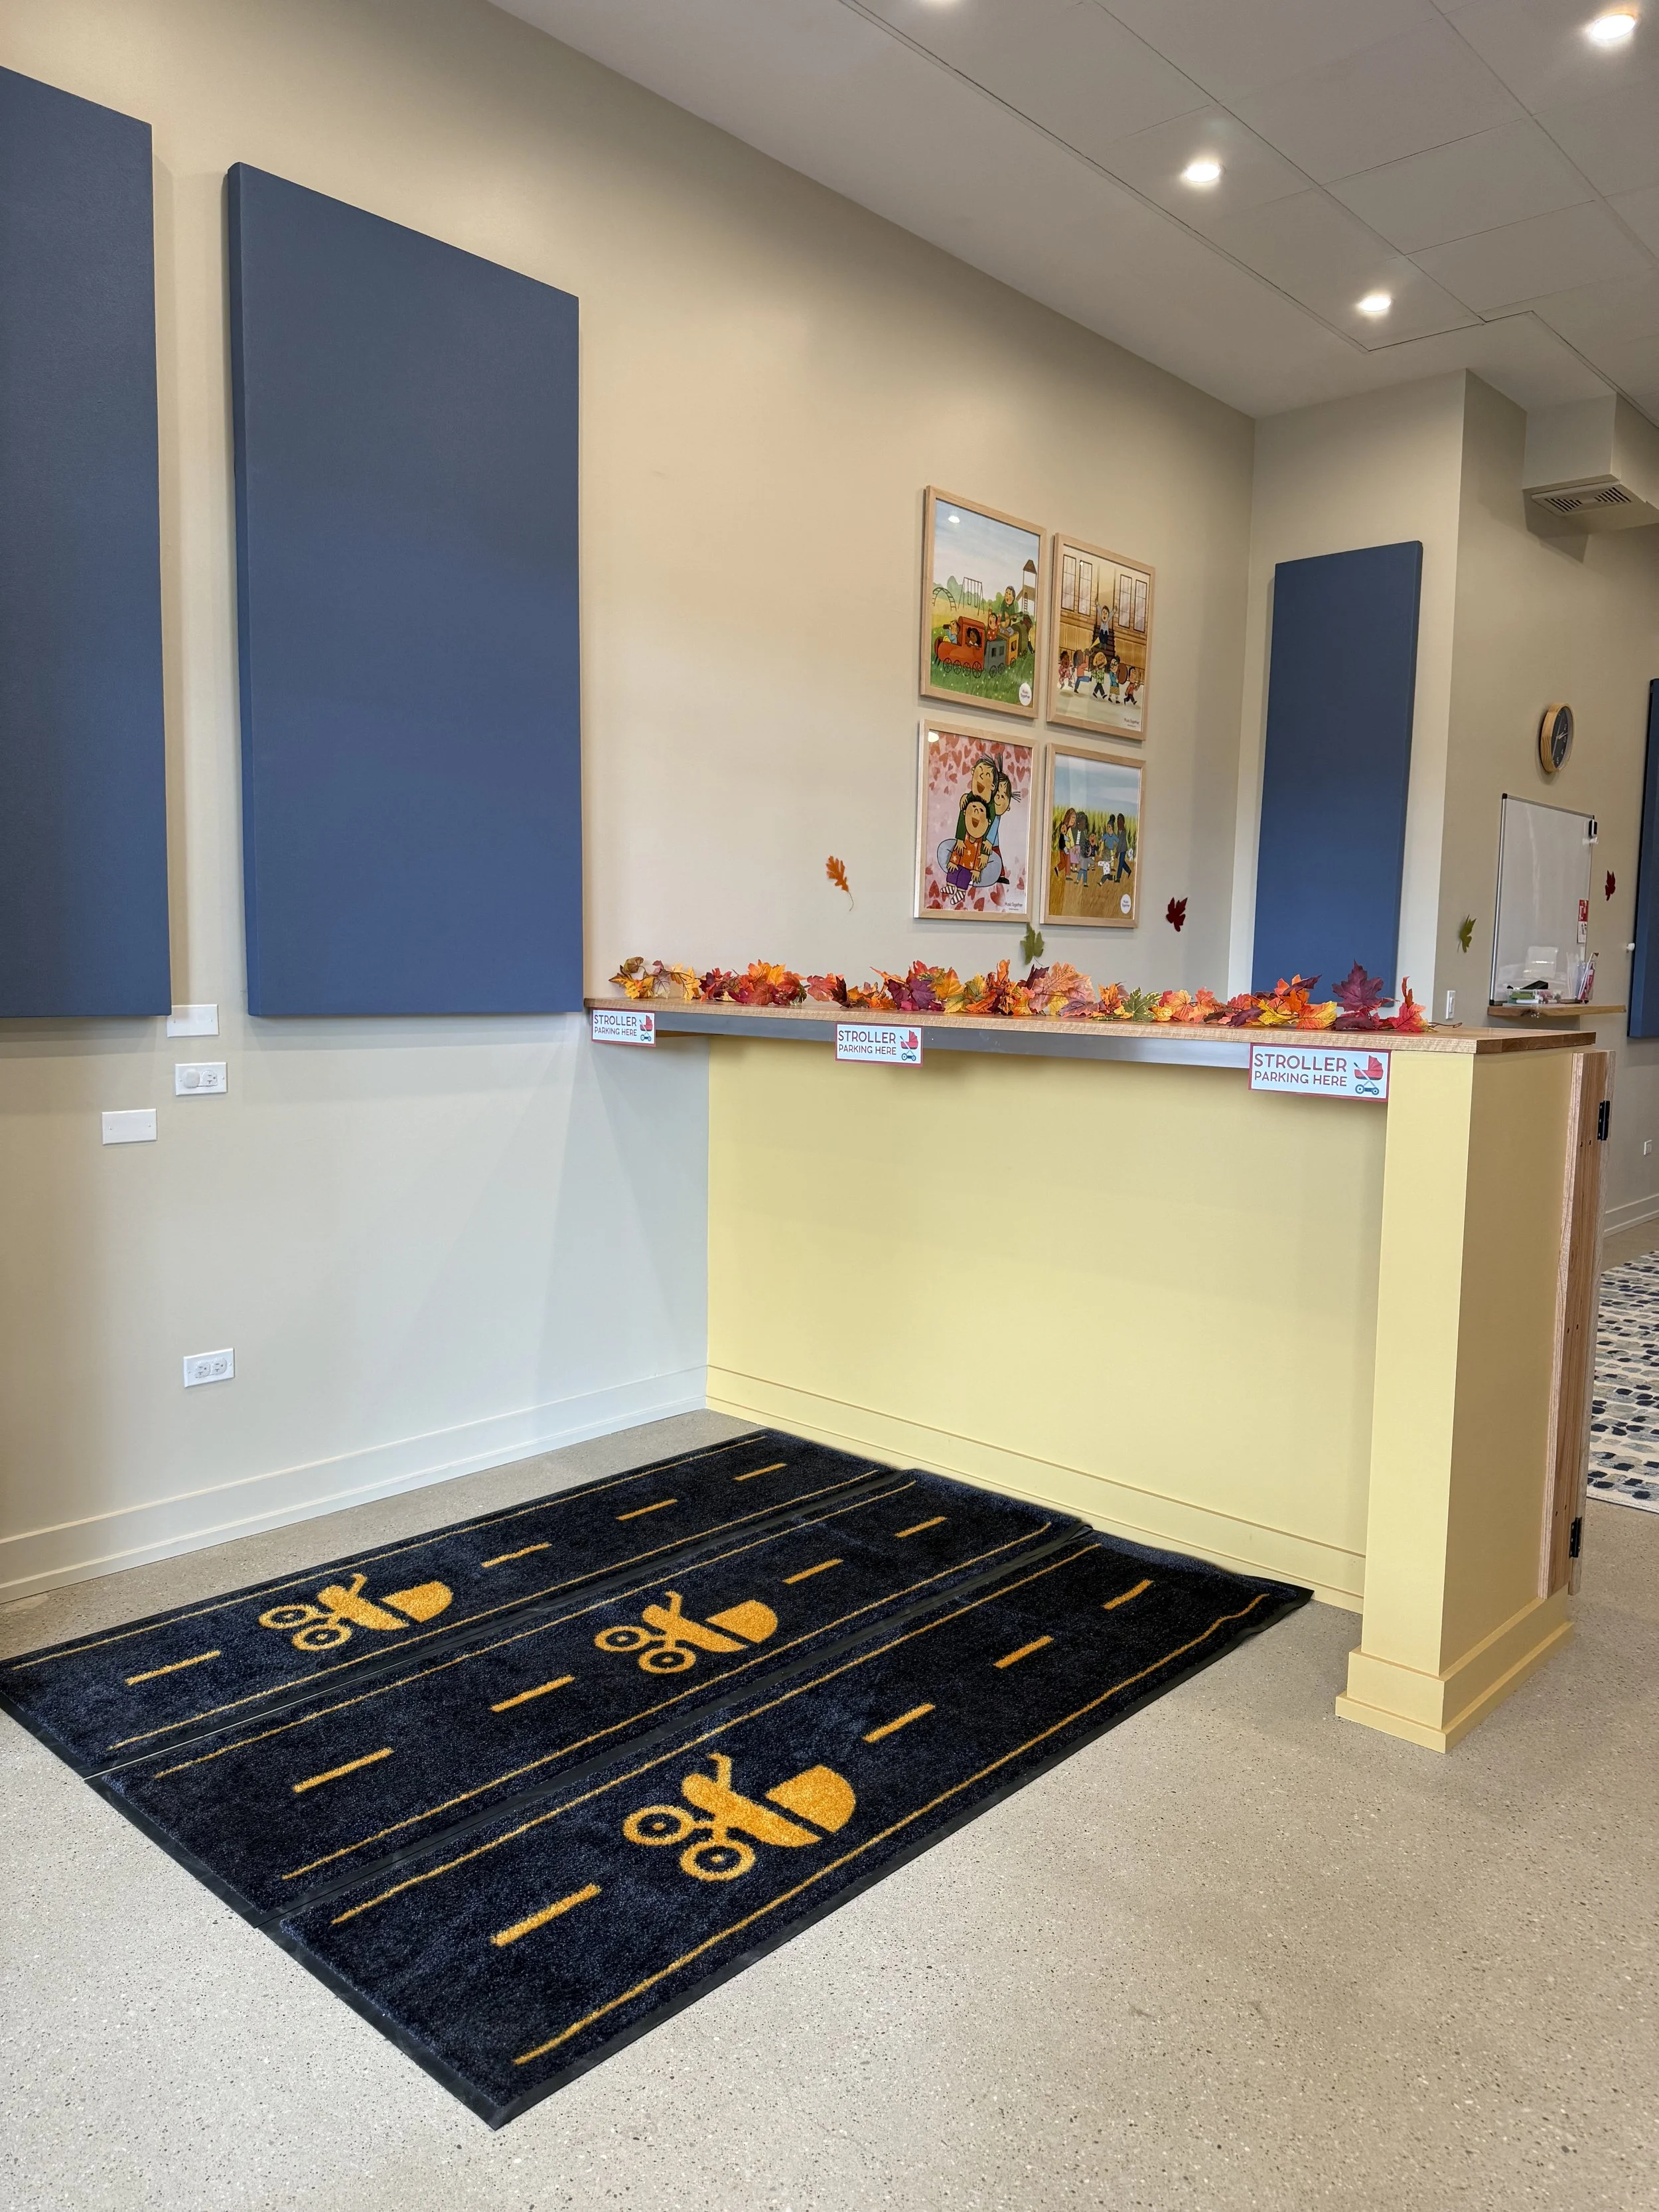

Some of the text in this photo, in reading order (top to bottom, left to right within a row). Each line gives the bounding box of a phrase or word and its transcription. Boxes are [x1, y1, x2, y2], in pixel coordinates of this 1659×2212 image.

[594, 1014, 637, 1027] STROLLER
[595, 1026, 637, 1037] PARKING HERE
[838, 1030, 896, 1044] STROLLER
[839, 1044, 897, 1055] PARKING HERE
[1254, 1053, 1347, 1072] STROLLER
[1254, 1070, 1348, 1087] PARKING HERE
